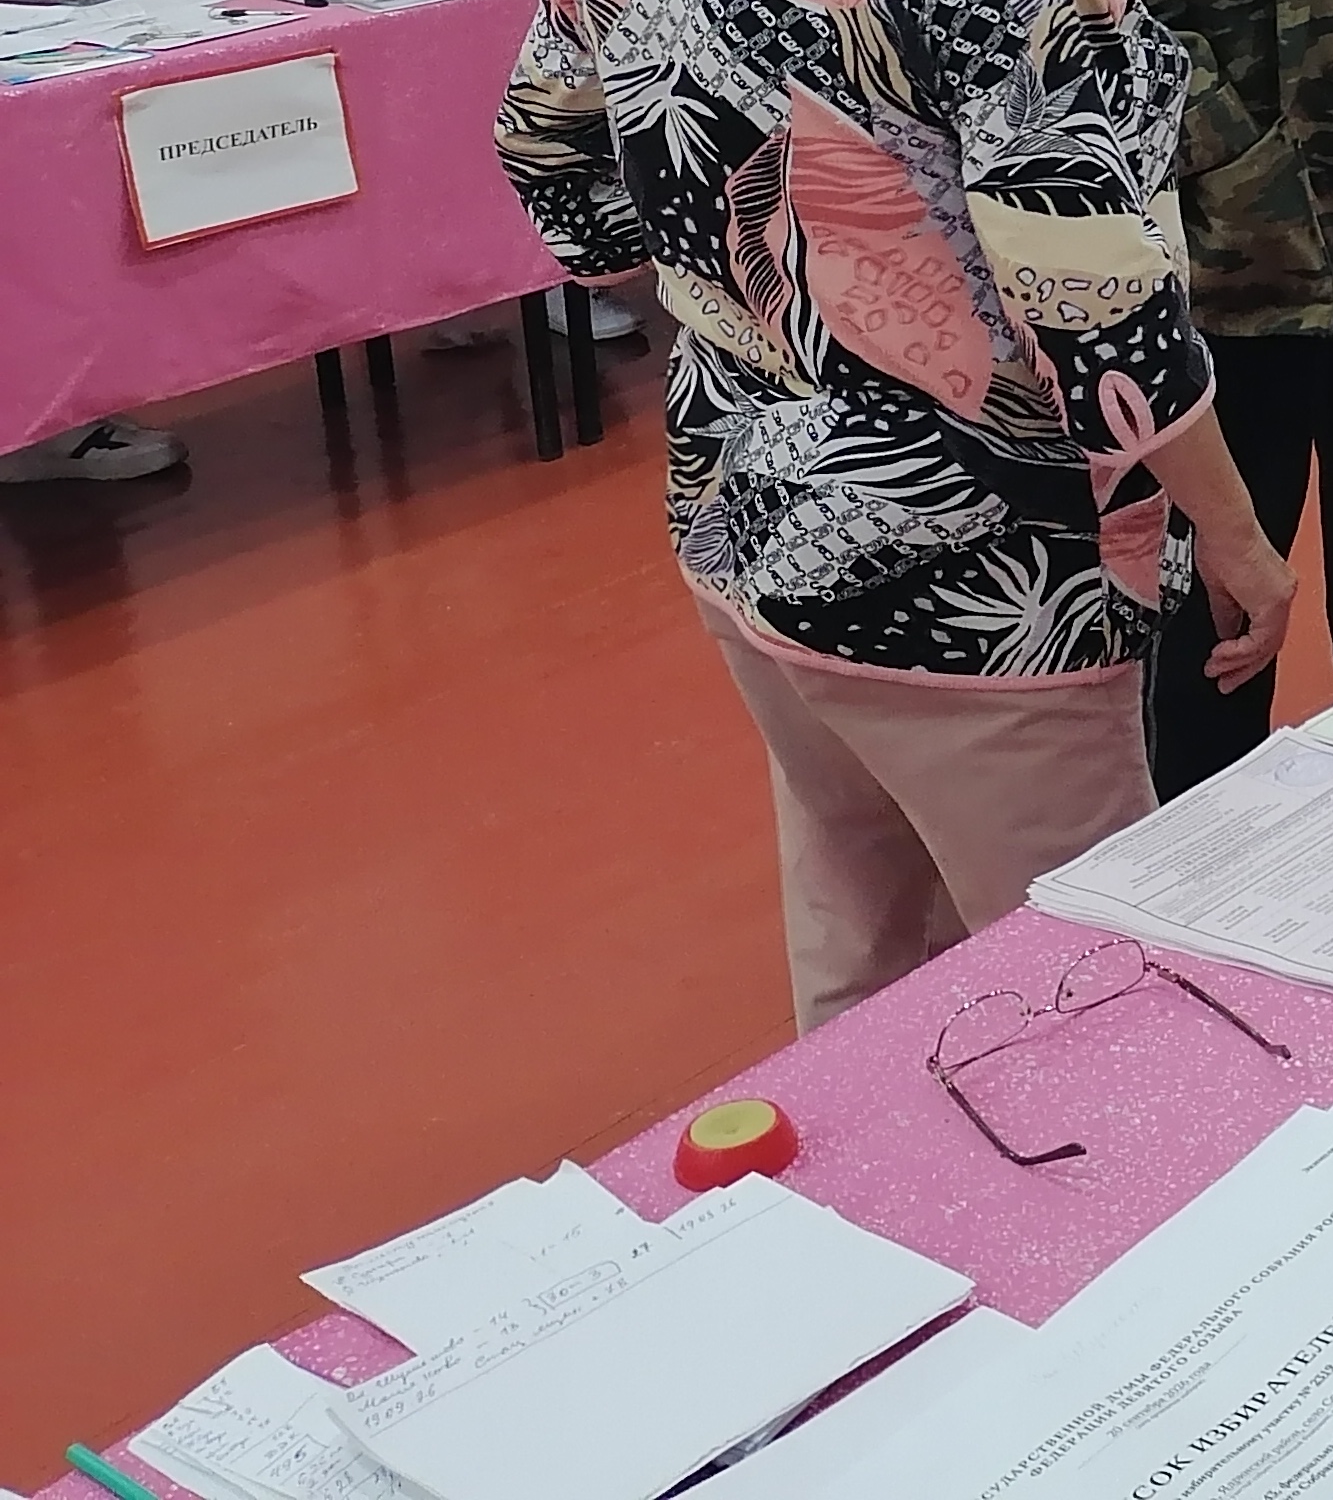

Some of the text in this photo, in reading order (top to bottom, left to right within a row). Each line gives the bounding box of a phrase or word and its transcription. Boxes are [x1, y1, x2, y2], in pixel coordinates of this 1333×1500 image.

[158, 116, 319, 162] ПРЕДСЕДАТЕЛЬ
[1104, 1372, 1151, 1406] ДУМЫ
[1149, 1284, 1252, 1372] ФЕДЕРАЛЬНОГО
[1250, 1232, 1318, 1284] СОБРАНИЯ
[1029, 1408, 1118, 1478] ФЕДЕРАЦИИ
[1116, 1356, 1189, 1411] ДЕВЯТОГО
[1188, 1309, 1244, 1355] СОЗЫВА
[1180, 1432, 1264, 1498] избирательному
[1260, 1393, 1303, 1435] участку
